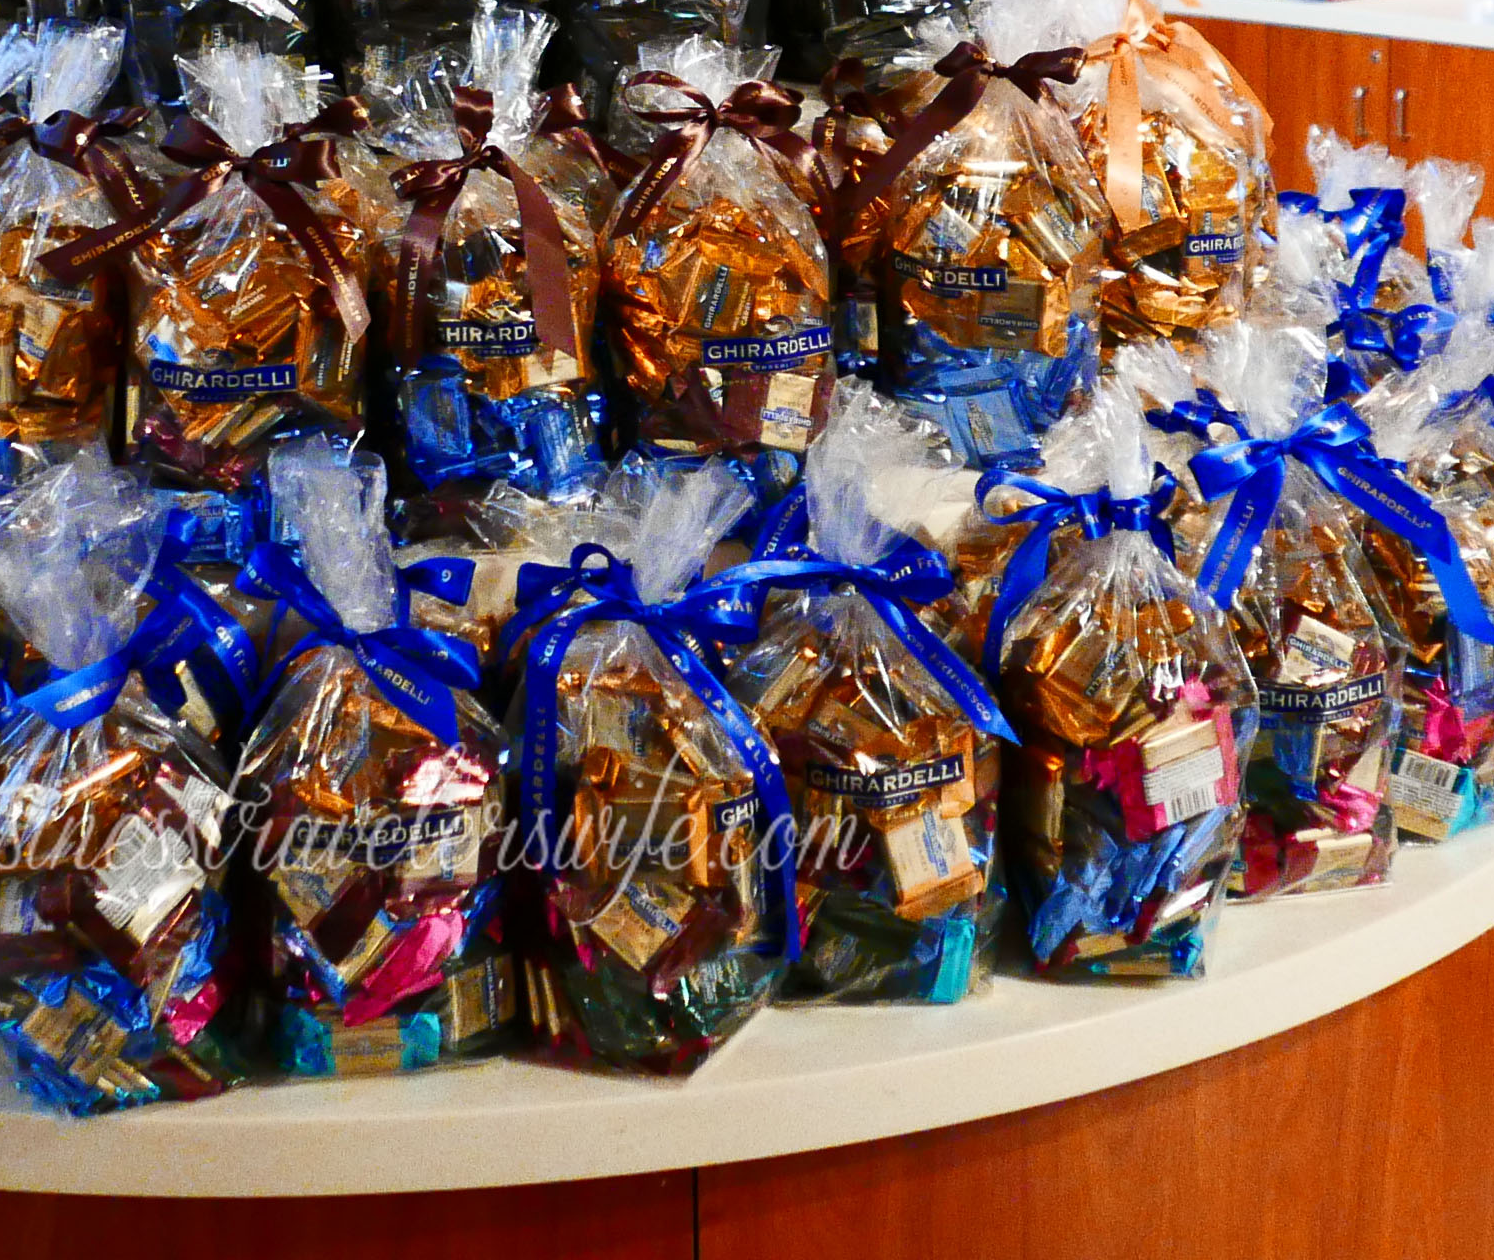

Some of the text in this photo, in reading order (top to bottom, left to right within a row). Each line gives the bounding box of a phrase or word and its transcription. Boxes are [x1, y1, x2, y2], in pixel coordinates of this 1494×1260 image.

[307, 226, 356, 320] GHIRARDELLI
[895, 257, 1001, 287] GHIRRDELLI
[704, 266, 730, 330] GHIRARDELLI
[441, 323, 535, 343] HIRARD
[708, 330, 833, 360] GHIRARDELLI
[152, 365, 291, 388] GHIRARDELLI
[1337, 466, 1427, 529] GHIRARDELLI
[763, 495, 805, 558] rancisco
[1290, 638, 1351, 670] GHIRARDELLI
[1258, 679, 1382, 708] GHIRARDELLI
[810, 761, 961, 792] GHIRARDELLI
